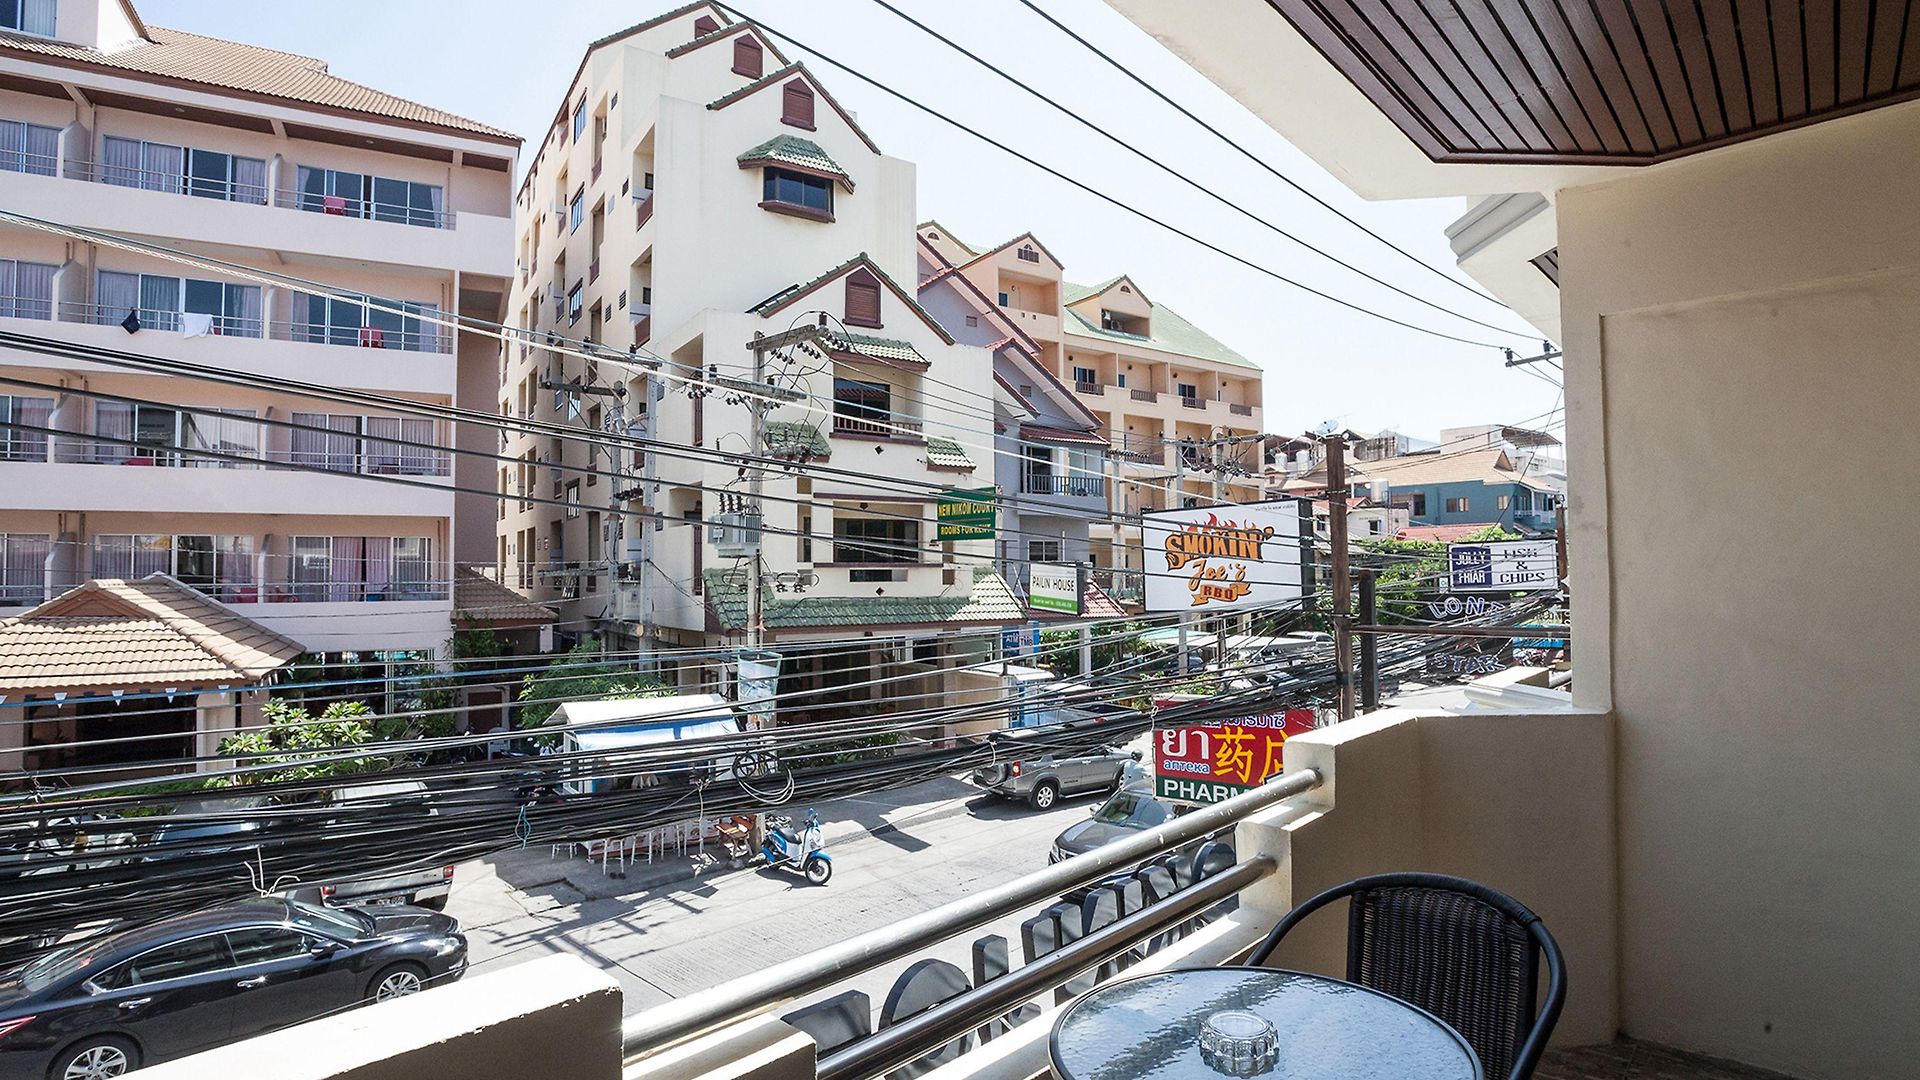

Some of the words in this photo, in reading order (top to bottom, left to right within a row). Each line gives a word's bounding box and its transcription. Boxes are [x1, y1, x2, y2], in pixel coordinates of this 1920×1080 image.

[938, 504, 951, 517] NEW
[951, 502, 972, 516] NIKOM
[972, 500, 994, 514] COURT
[940, 525, 961, 535] ROOMS
[961, 525, 974, 534] FOR
[974, 523, 991, 534] RENT
[1455, 551, 1486, 566] JOLLY
[1188, 560, 1246, 591] Joe's
[1458, 570, 1486, 584] FRIAR
[1500, 572, 1546, 583] CHIPS
[1032, 576, 1051, 588] PAILIN
[1053, 578, 1075, 592] HOUSE
[1162, 729, 1210, 760] ยา
[1164, 760, 1210, 774] аптека
